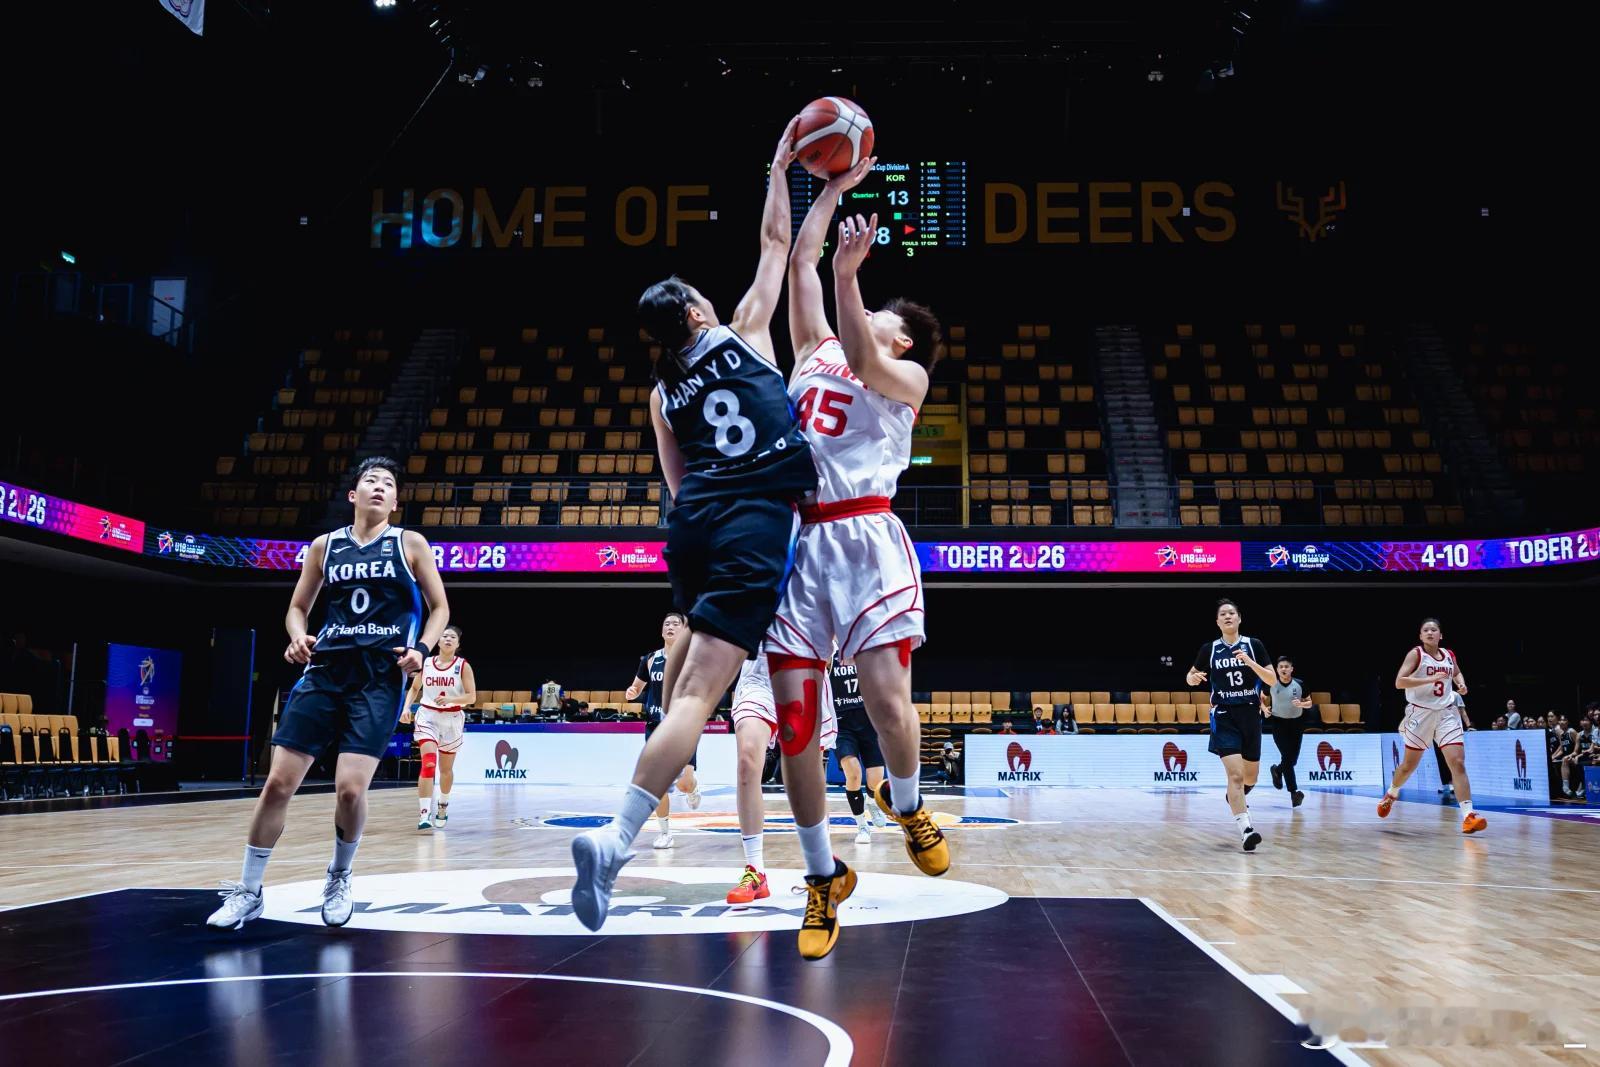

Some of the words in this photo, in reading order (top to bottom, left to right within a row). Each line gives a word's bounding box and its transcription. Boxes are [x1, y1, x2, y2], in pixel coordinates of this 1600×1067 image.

[876, 164, 886, 172] Cup
[888, 190, 908, 206] 13
[370, 186, 587, 248] HOME
[615, 185, 710, 247] OF
[984, 181, 1237, 244] DEERS
[906, 248, 914, 256] 3
[670, 377, 704, 409] HAN
[705, 361, 721, 380] Y
[722, 350, 742, 370] D
[796, 386, 854, 438] 45
[703, 388, 756, 457] 8
[174, 542, 186, 553] U18
[622, 554, 636, 564] U18
[1180, 554, 1194, 564] U18
[1292, 554, 1308, 564] U18
[1422, 544, 1468, 568] 4-10
[328, 560, 397, 584] KOREA
[350, 588, 370, 614] 0
[368, 622, 400, 635] Bank
[1215, 658, 1248, 670] KORE
[834, 665, 858, 676] KOR
[426, 676, 454, 687] CHINA
[1226, 670, 1244, 687] 13
[844, 678, 858, 694] 17
[1434, 680, 1444, 698] 3
[1226, 690, 1244, 698] Hana
[485, 769, 527, 778] MATRIX
[998, 772, 1042, 781] MATRIX
[1154, 772, 1198, 781] MATRIX
[1309, 771, 1352, 780] MATRIX
[1514, 778, 1532, 791] MATRIX
